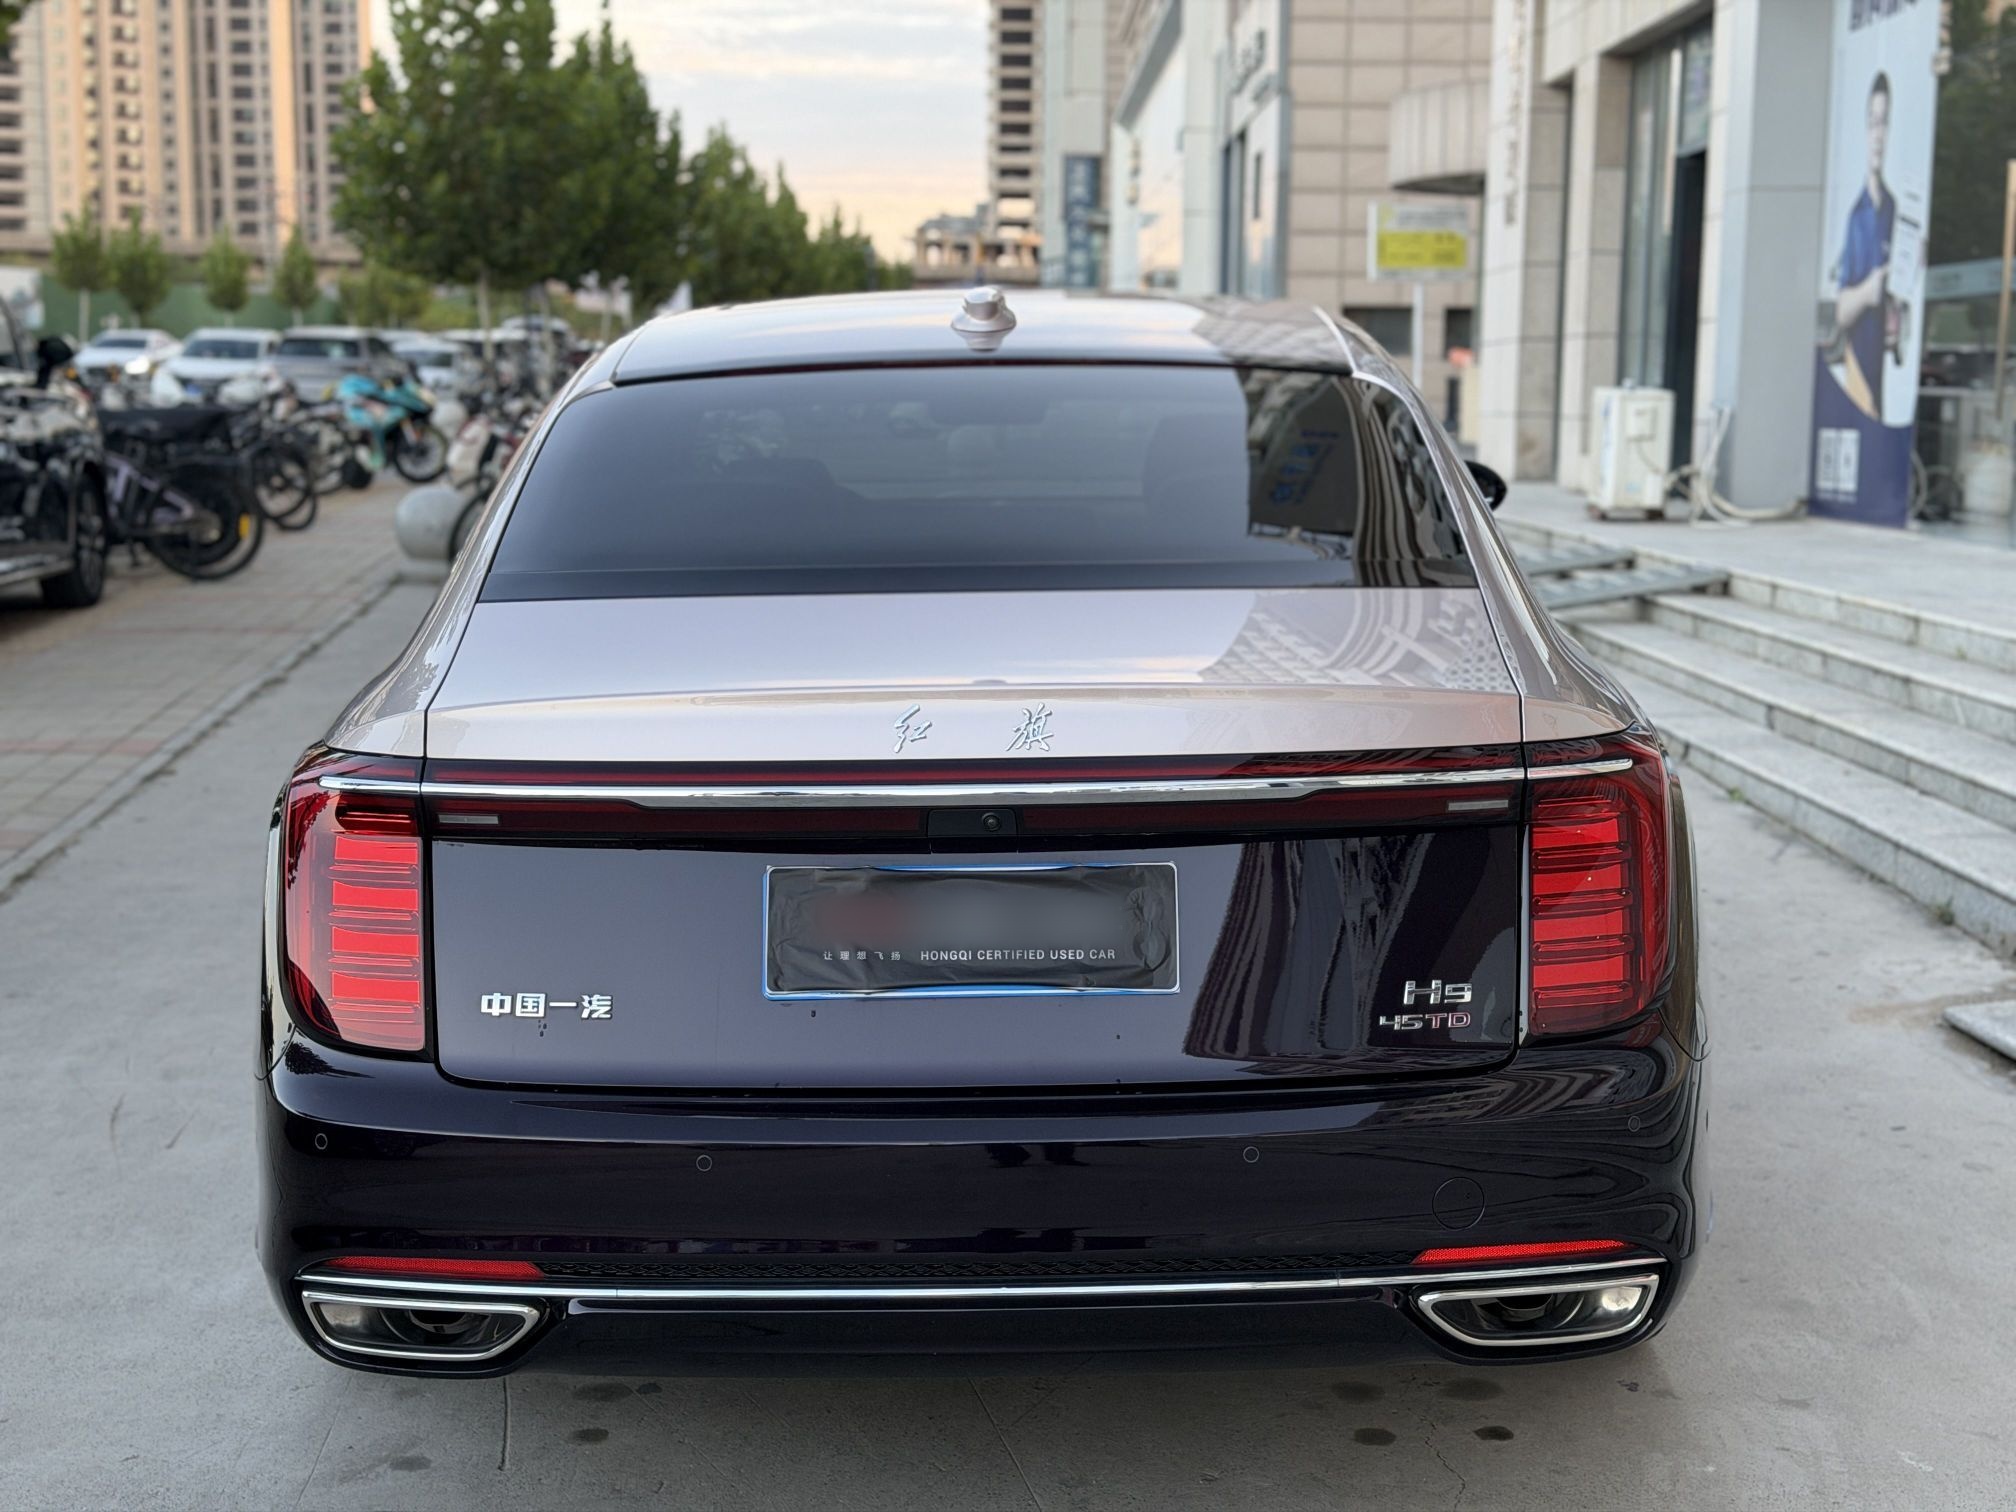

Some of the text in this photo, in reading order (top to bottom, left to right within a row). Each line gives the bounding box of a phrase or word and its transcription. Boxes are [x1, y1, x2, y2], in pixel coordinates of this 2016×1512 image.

[893, 702, 1054, 753] 红旗
[823, 948, 1116, 961] 让理想飞扬 HONGQI CERTIFIED USED CAR
[1403, 980, 1472, 1005] H9
[480, 992, 613, 1020] 中国一汽
[1379, 1011, 1471, 1031] 45TD
